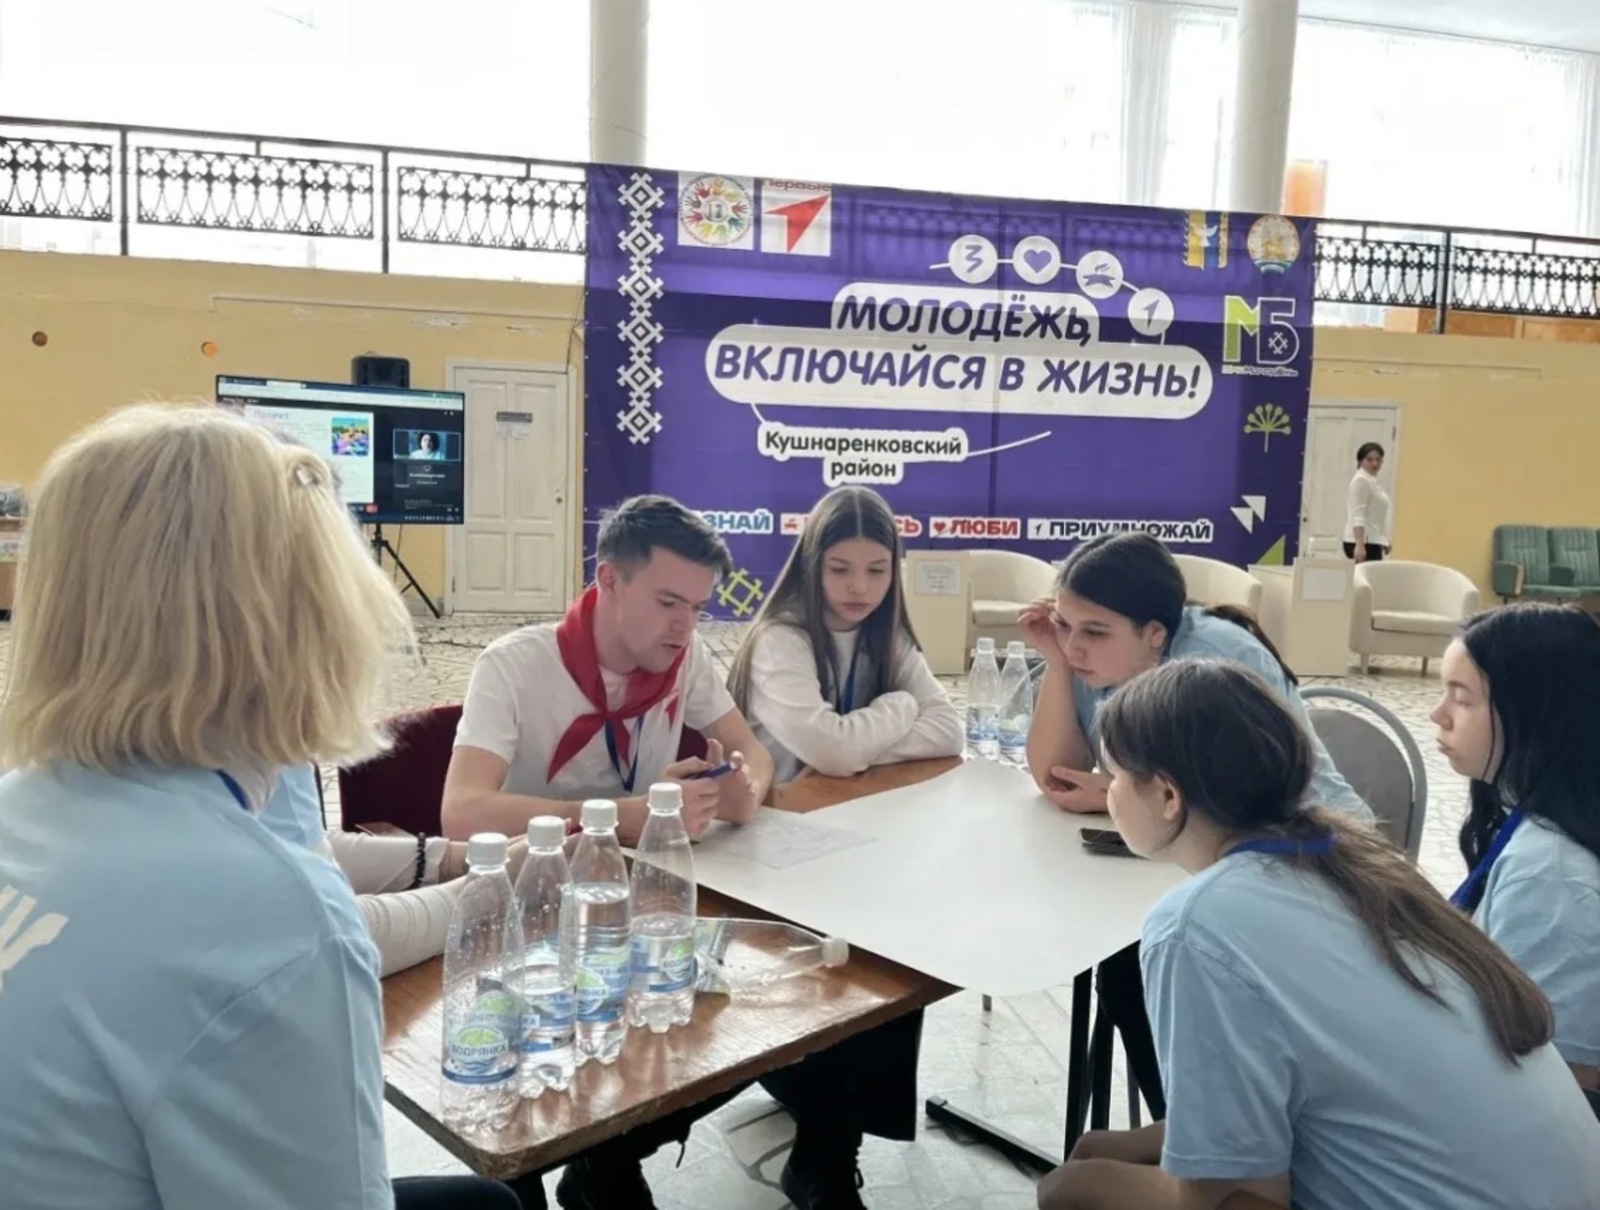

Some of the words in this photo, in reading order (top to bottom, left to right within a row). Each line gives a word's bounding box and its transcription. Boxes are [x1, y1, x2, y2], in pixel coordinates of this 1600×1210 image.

[836, 293, 1092, 347] МОЛОДЁЖЬ,
[714, 343, 987, 391] ВКЛЮЧАЙСЯ
[999, 357, 1026, 391] В
[1036, 359, 1201, 400] ЖИЗНЬ!
[765, 431, 962, 456] Кушнаренковский
[831, 459, 897, 480] район
[702, 511, 771, 531] ЗНАЙ
[950, 518, 1019, 536] ЛЮБИ
